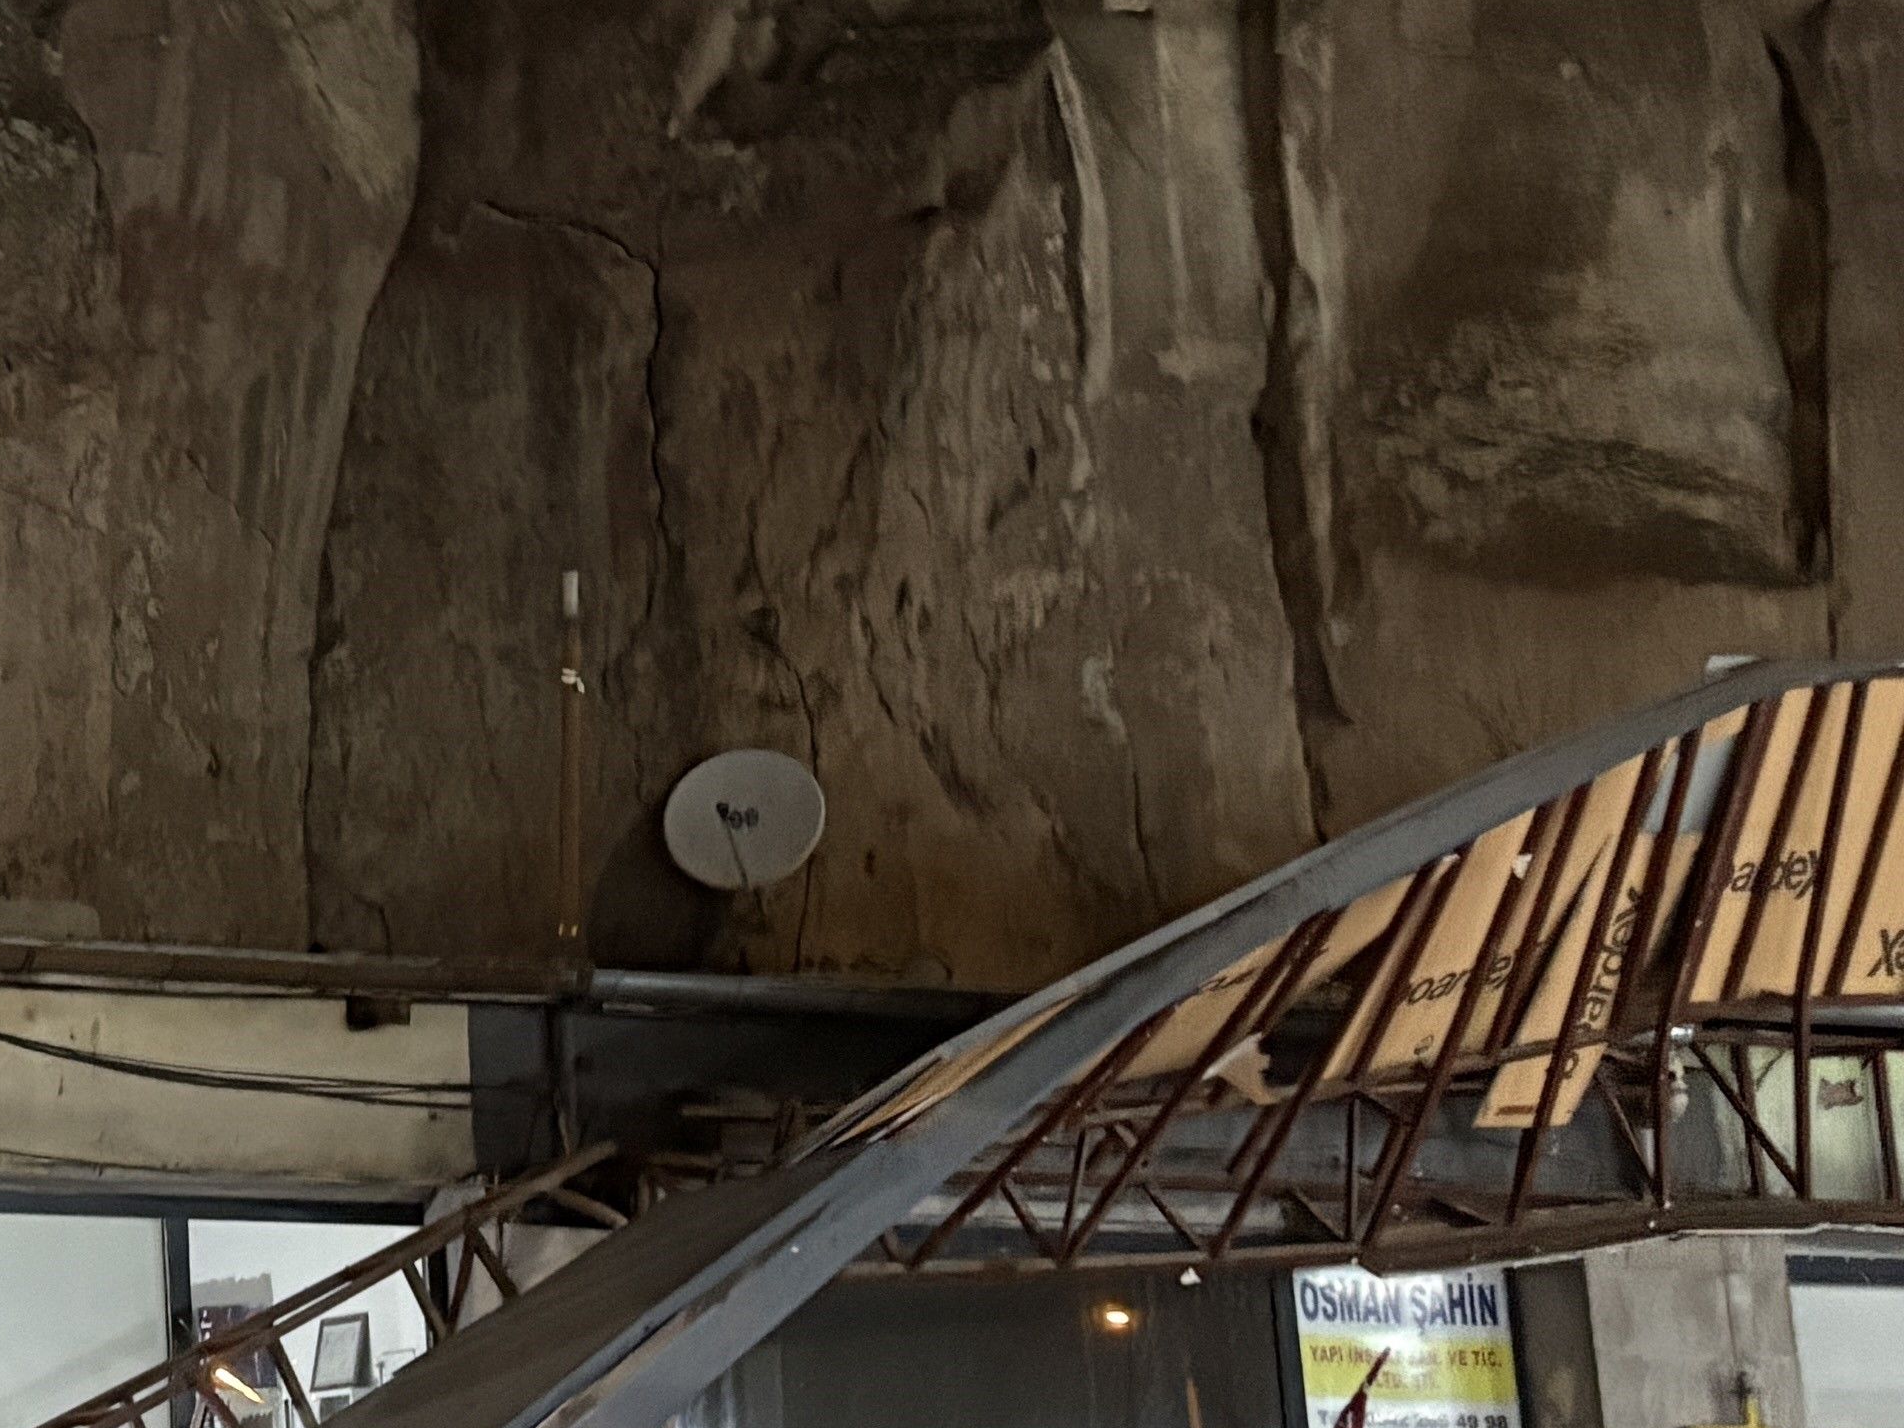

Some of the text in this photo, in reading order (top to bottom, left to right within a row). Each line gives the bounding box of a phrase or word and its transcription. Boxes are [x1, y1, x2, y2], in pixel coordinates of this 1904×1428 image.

[1300, 1272, 1499, 1336] OSMAN ŞAHİN
[1309, 1344, 1343, 1363] YAPI
[1448, 1349, 1468, 1367] VE
